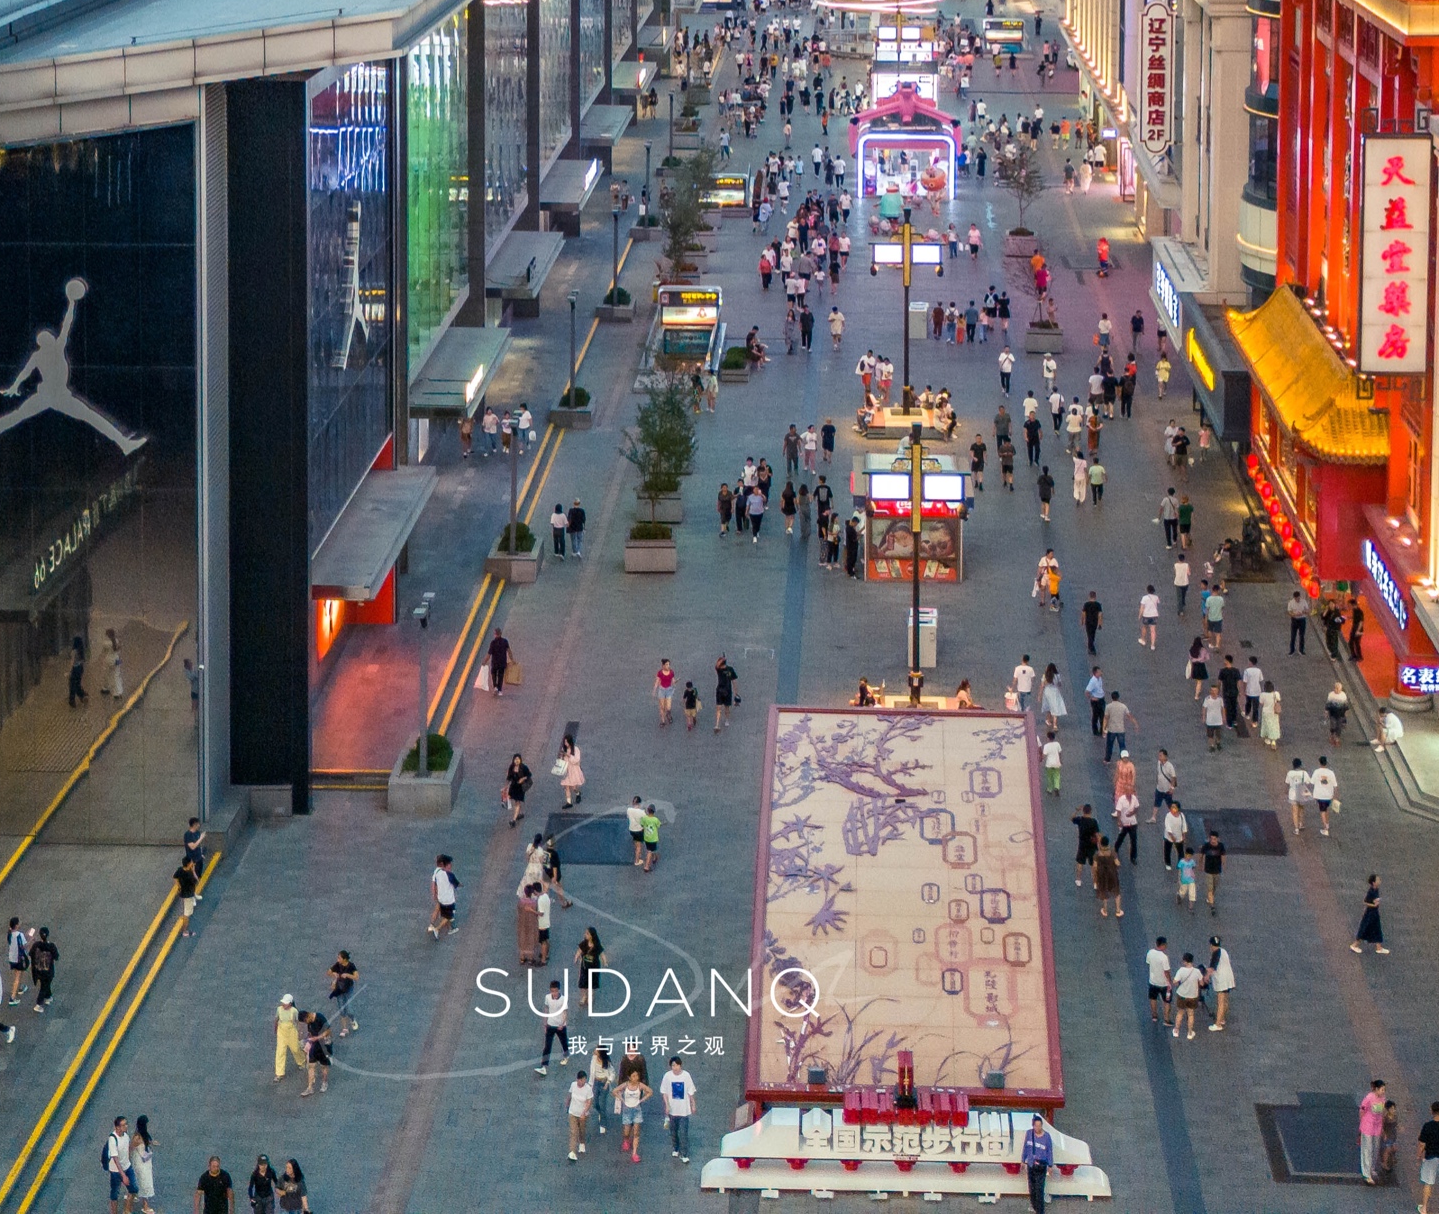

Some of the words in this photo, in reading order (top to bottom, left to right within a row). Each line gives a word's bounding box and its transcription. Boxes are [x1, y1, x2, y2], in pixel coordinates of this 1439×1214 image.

[1147, 18, 1166, 126] 辽宁丝绸商店
[1147, 129, 1165, 141] 2F
[804, 1125, 1009, 1156] 全国示范步行街
